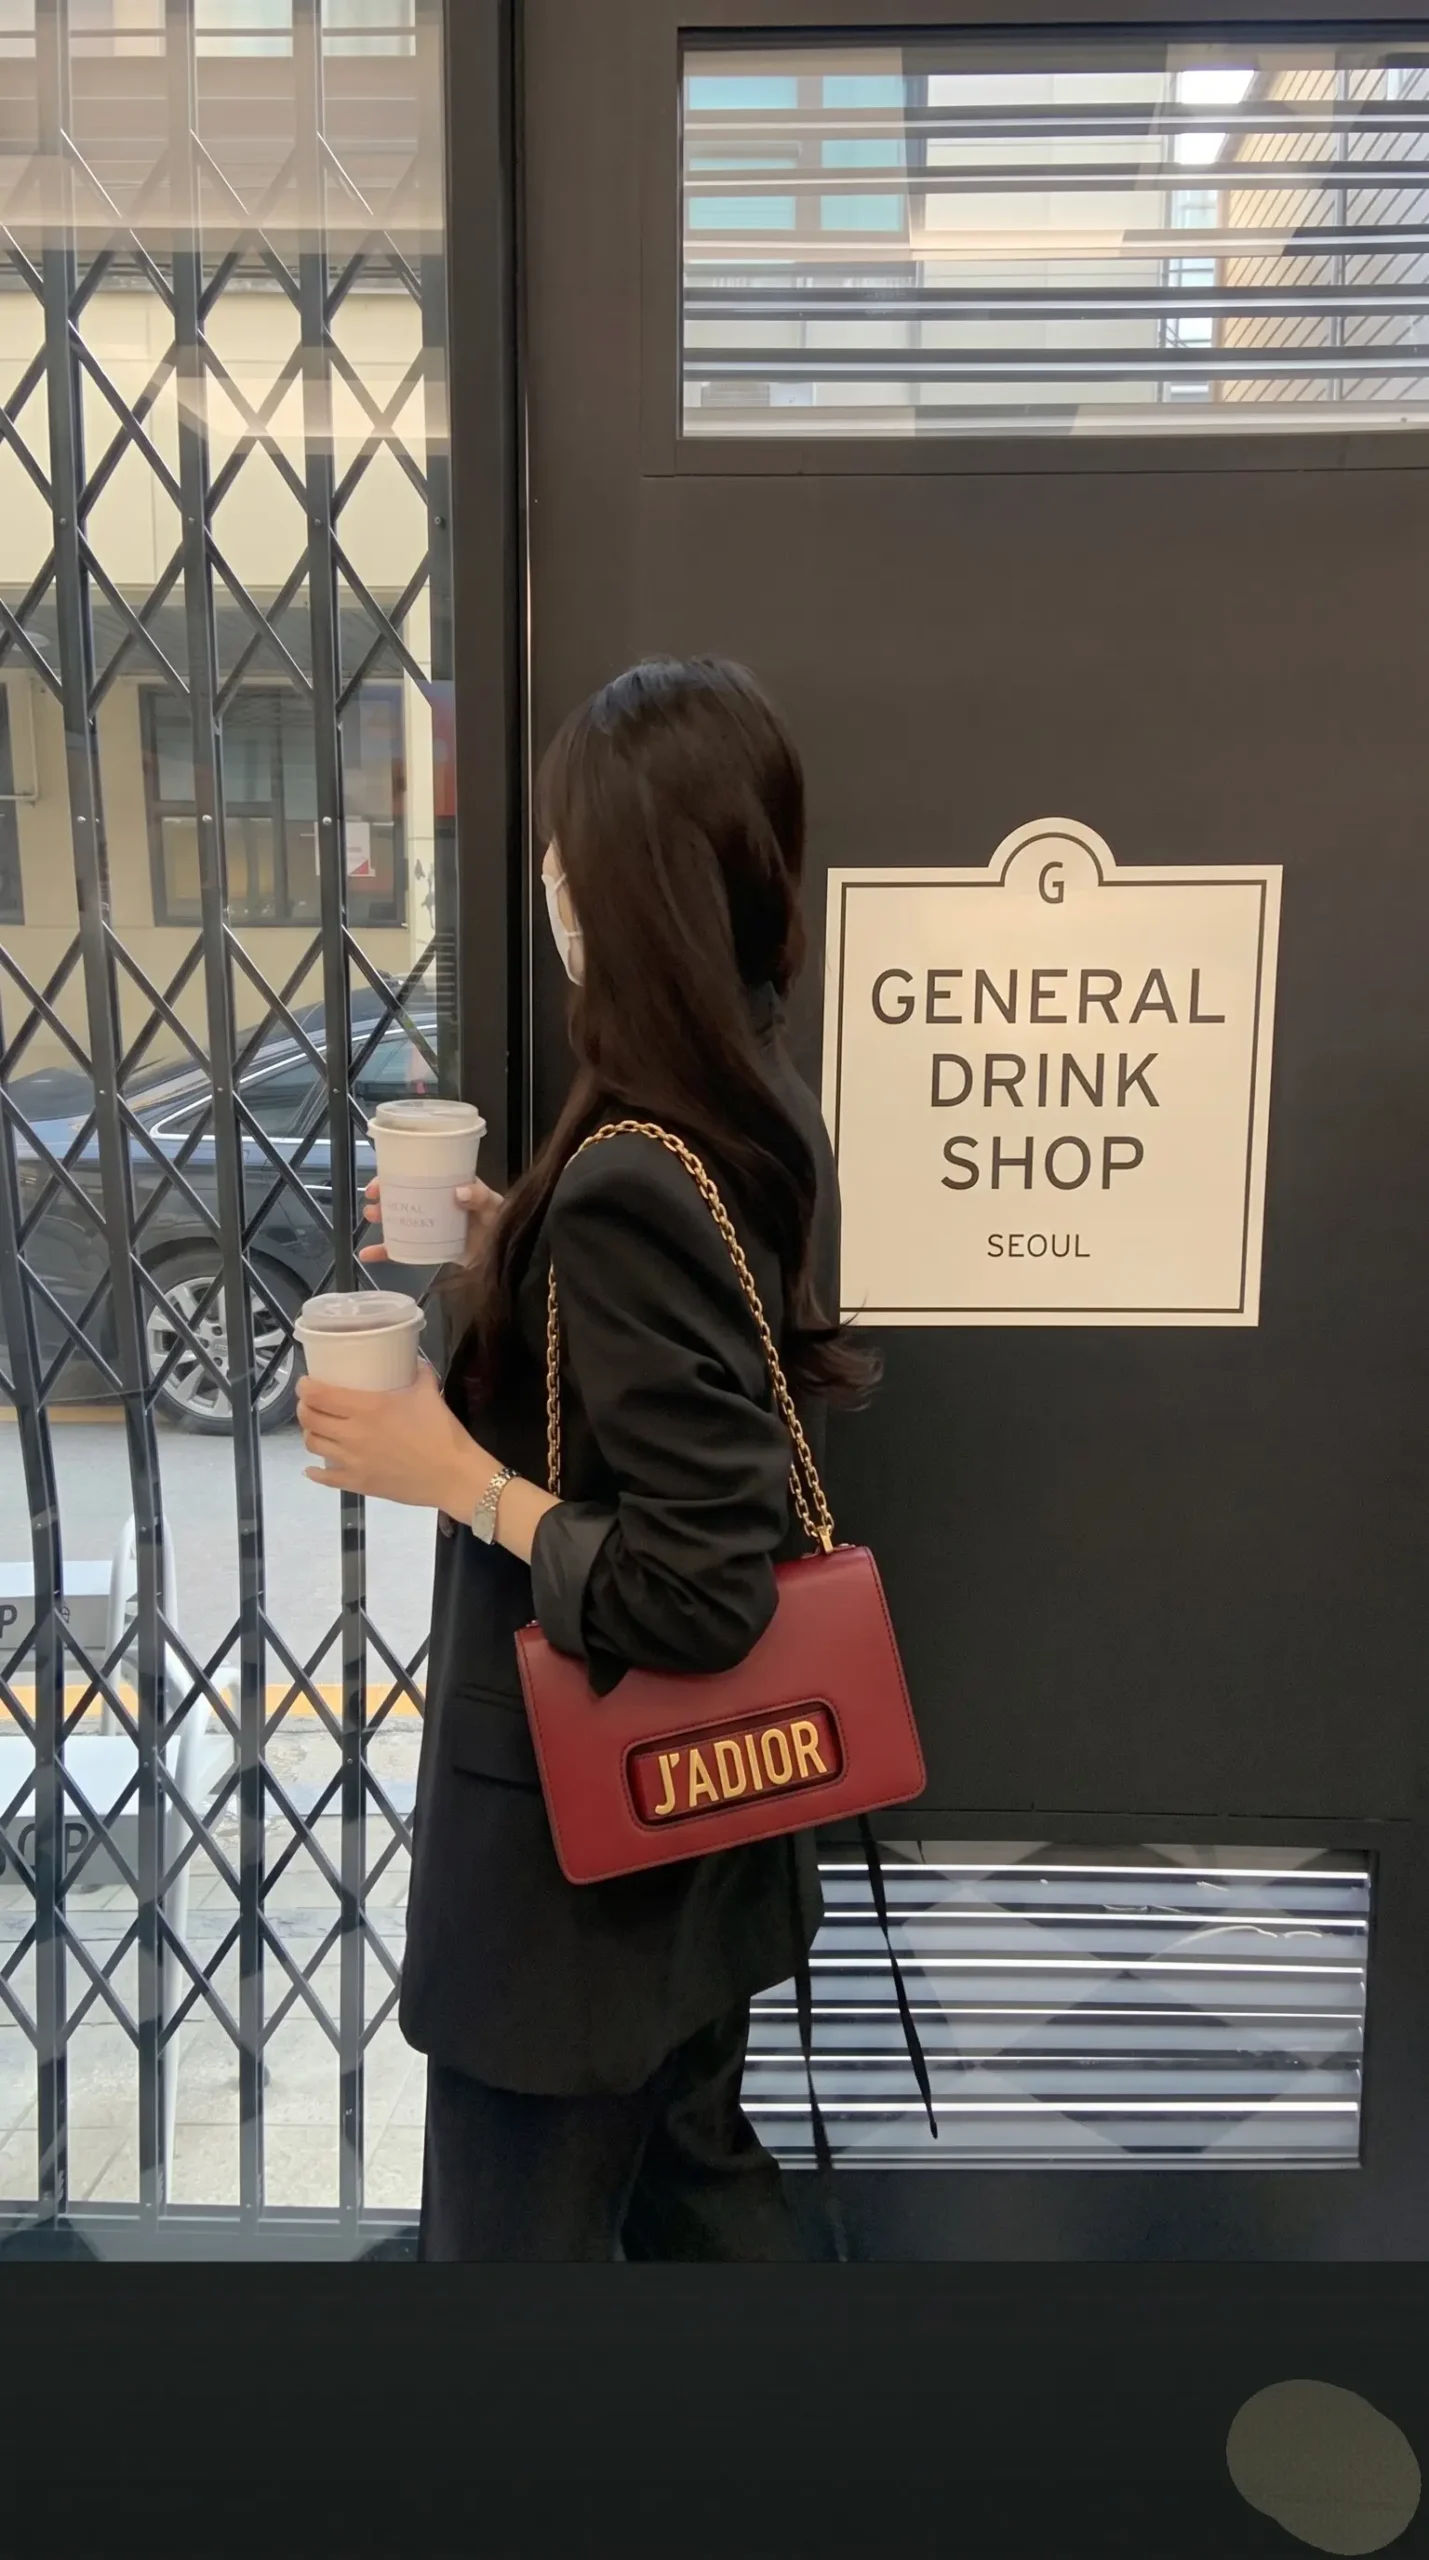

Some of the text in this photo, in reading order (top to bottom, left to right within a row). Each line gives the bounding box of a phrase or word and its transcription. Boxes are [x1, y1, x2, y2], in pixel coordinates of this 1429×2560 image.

[1038, 861, 1065, 904] G
[871, 968, 1226, 1025] GENERAL
[930, 1052, 1160, 1108] DRINK
[940, 1135, 1144, 1191] SHOP
[987, 1233, 1091, 1258] SEOUL
[654, 1720, 828, 1816] J'ADIOR
